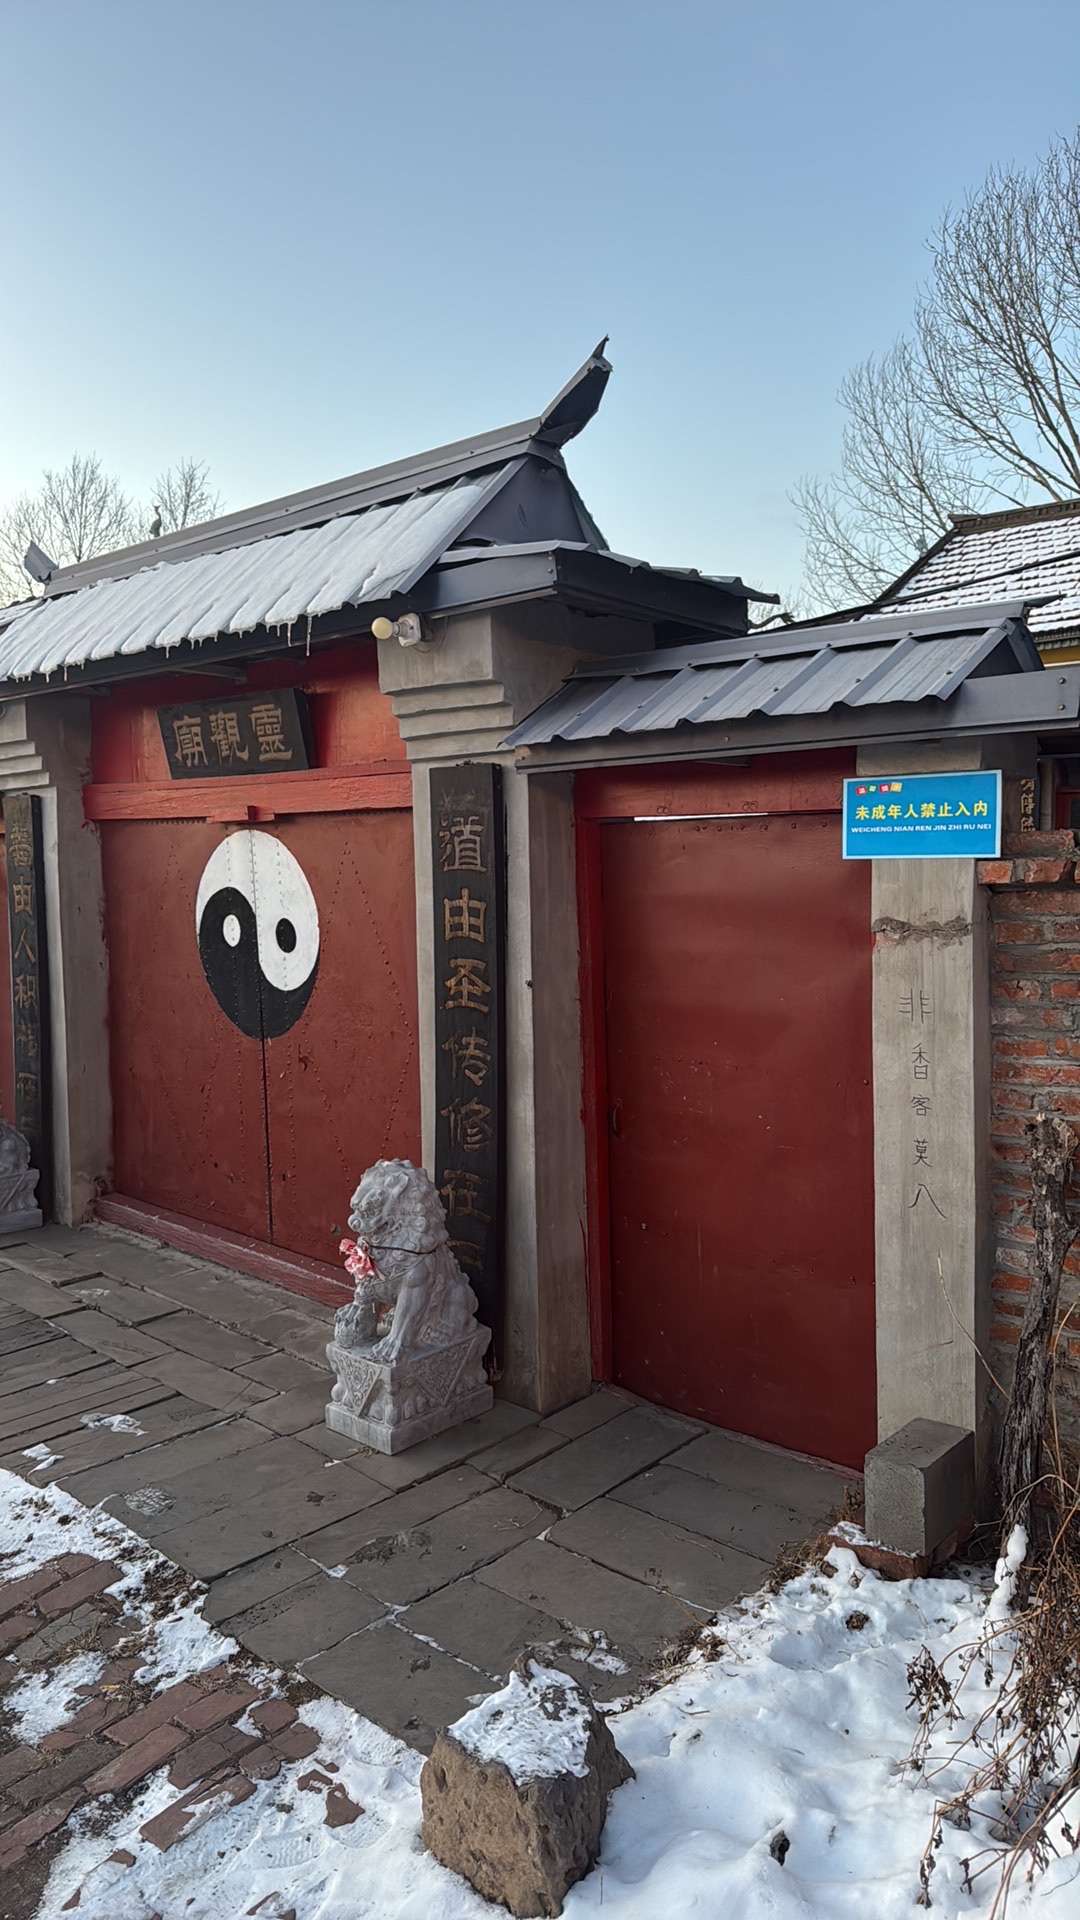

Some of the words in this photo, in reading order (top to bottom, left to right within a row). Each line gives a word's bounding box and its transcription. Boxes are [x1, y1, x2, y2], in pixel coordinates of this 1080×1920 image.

[854, 800, 988, 821] 未成年人禁止入内
